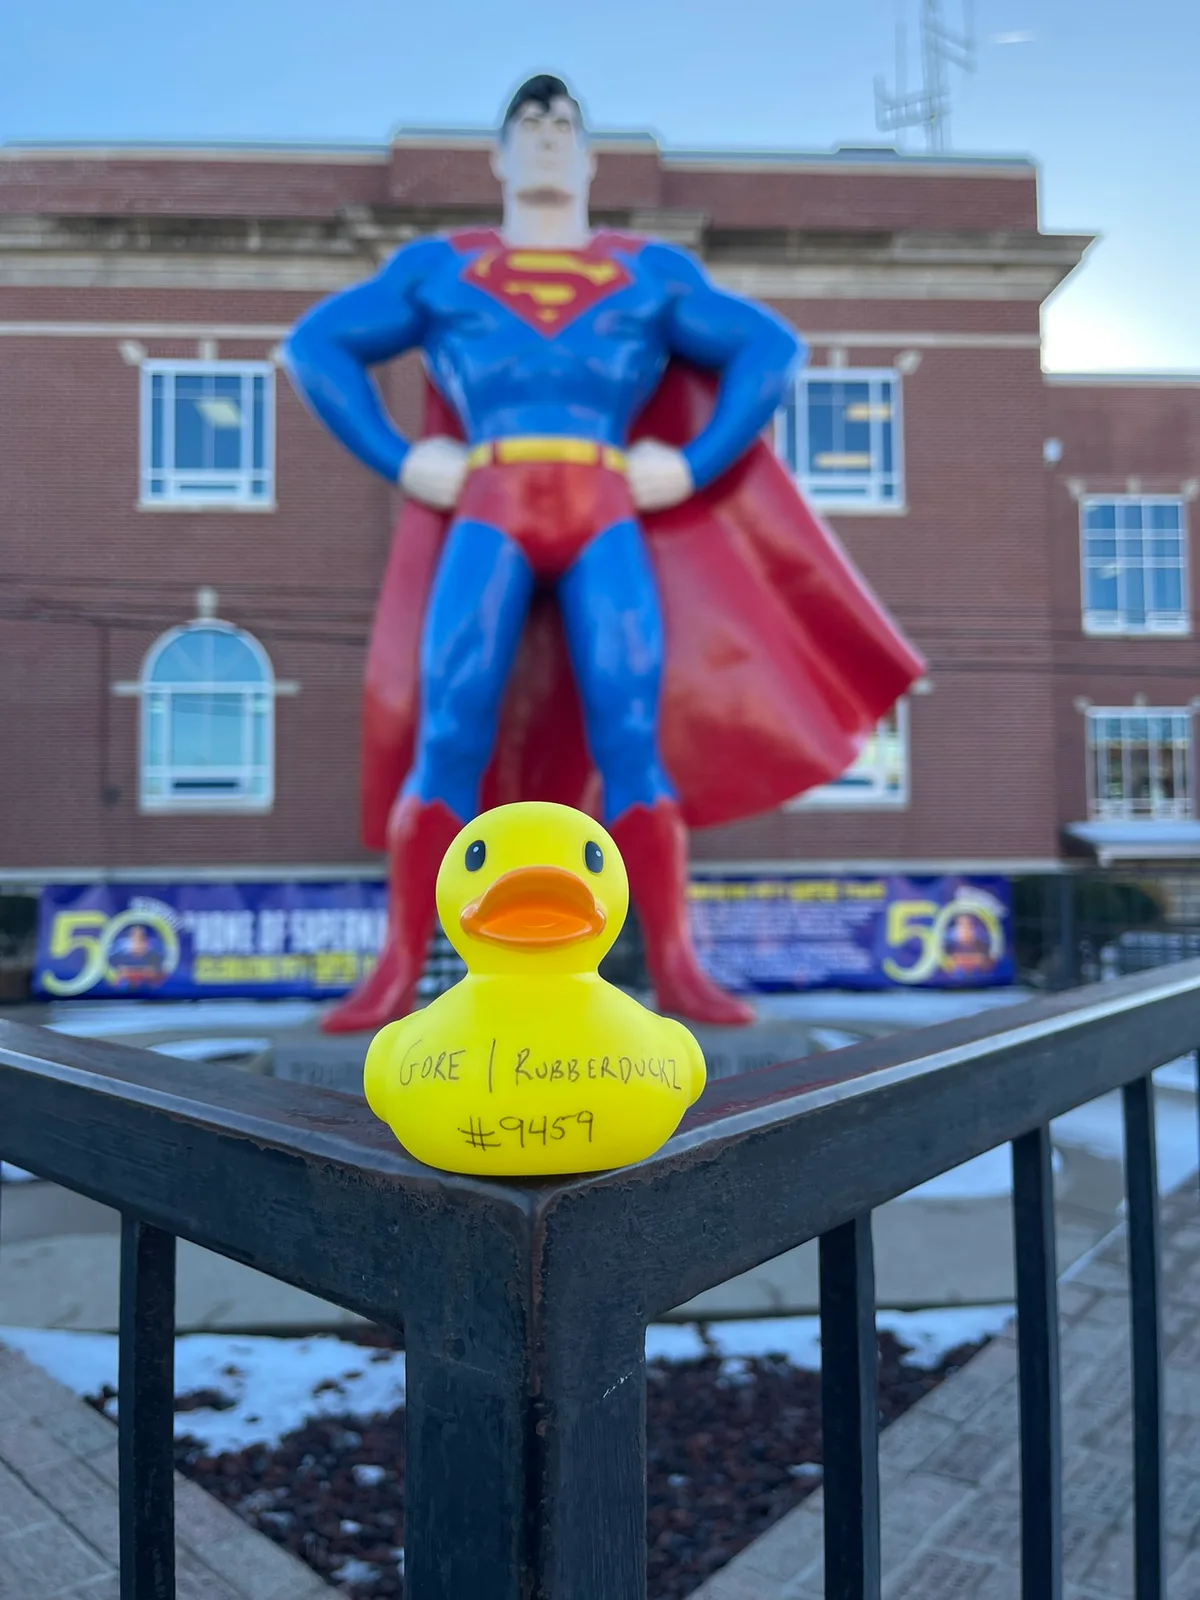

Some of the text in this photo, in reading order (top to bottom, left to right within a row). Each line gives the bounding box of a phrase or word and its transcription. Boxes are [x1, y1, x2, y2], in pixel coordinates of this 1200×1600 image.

[42, 908, 180, 996] 50
[884, 899, 1004, 984] 50
[400, 1038, 467, 1086] GORE
[457, 1109, 594, 1151] #9459
